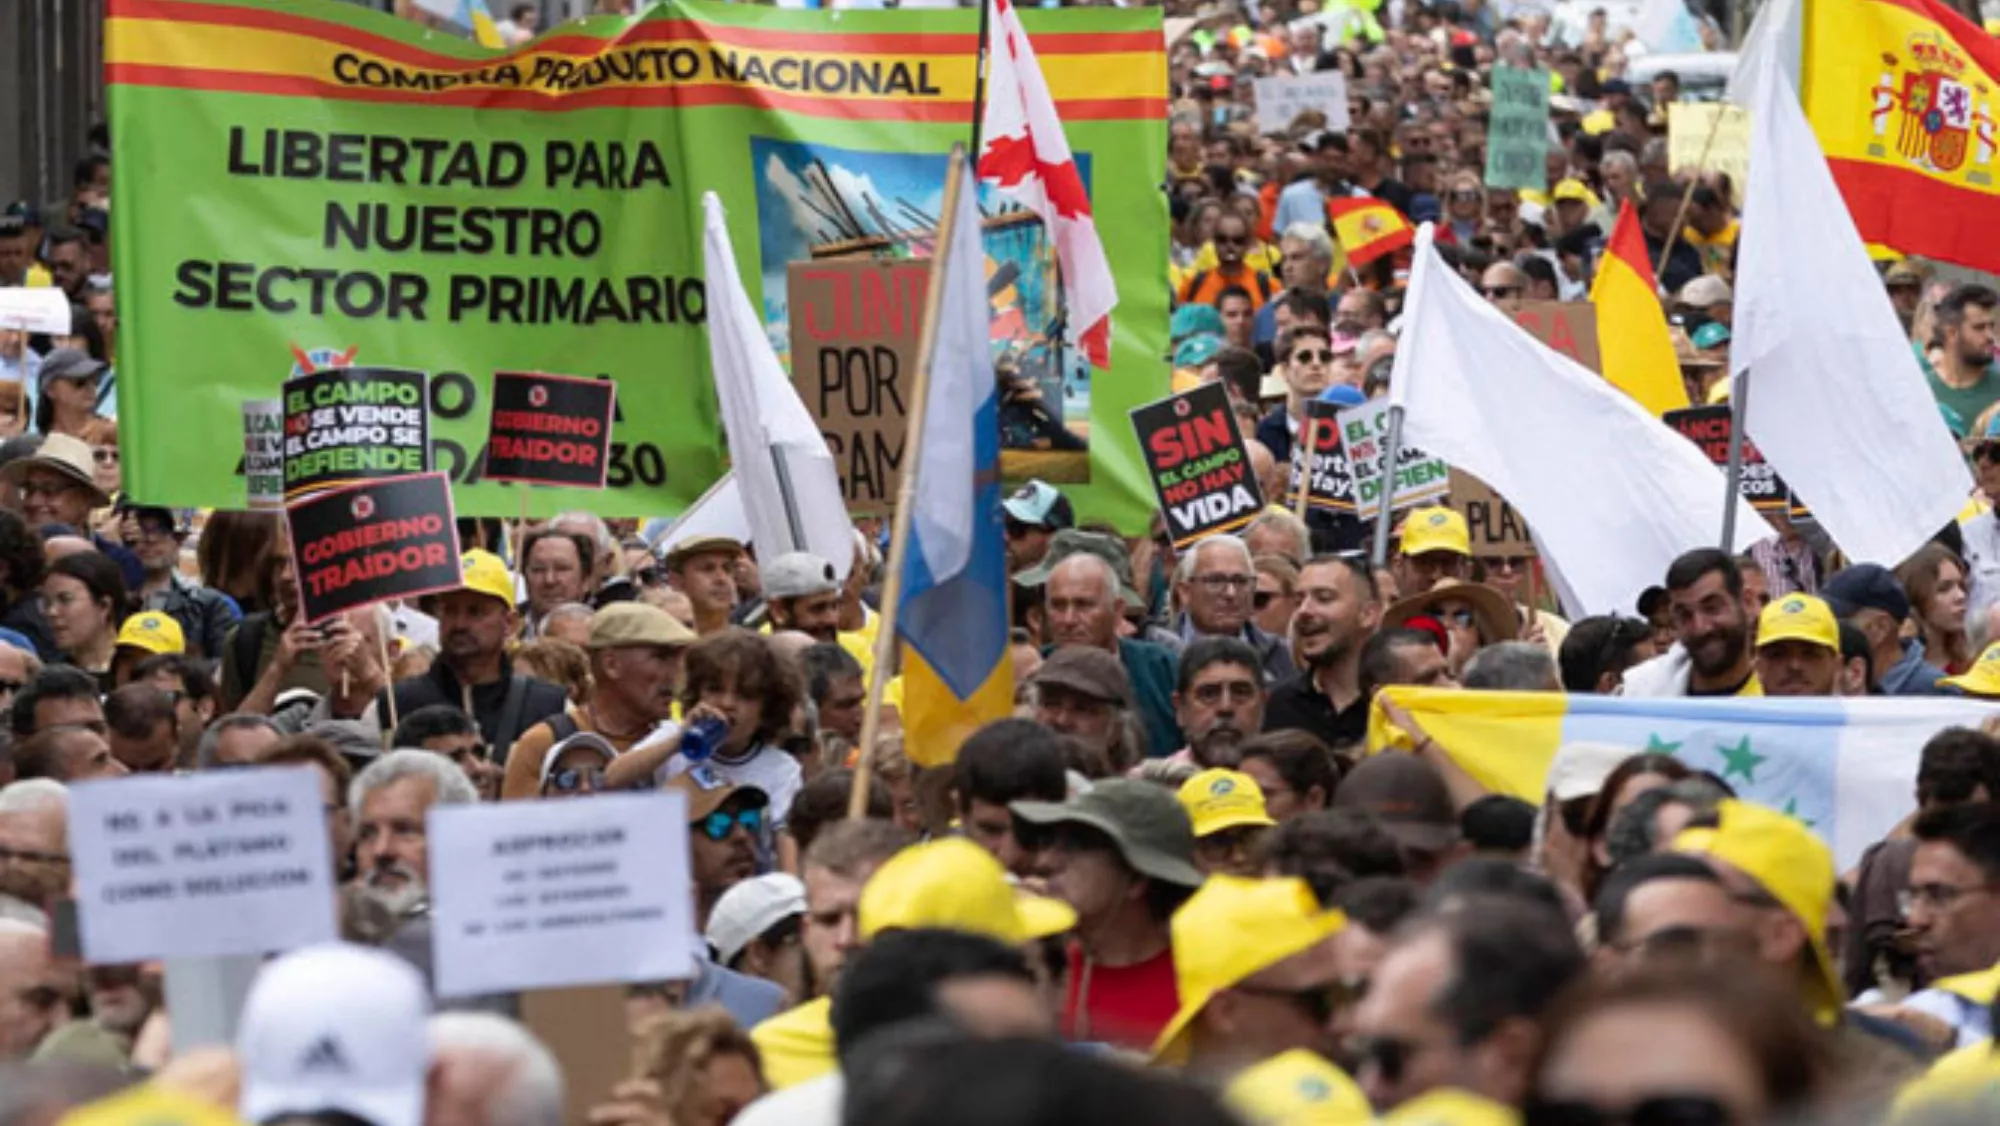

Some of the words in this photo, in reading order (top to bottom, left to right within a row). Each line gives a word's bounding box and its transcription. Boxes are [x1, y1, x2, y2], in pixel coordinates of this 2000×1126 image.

[710, 50, 940, 96] NACIONAL
[228, 126, 527, 189] LIBERTAD
[545, 140, 671, 190] PARA
[324, 202, 601, 257] NUESTRO
[173, 260, 428, 320] SECTOR
[449, 275, 707, 325] PRIMARIO
[804, 269, 929, 341] JUNT
[287, 390, 310, 413] EL
[313, 381, 419, 405] CAMPO
[819, 345, 905, 418] POR
[306, 426, 387, 449] CAMPO
[391, 427, 421, 445] SE
[311, 408, 335, 427] SE
[339, 405, 421, 426] VENDE
[1150, 408, 1233, 469] SIN
[1345, 419, 1372, 443] EL
[286, 447, 422, 482] DEFIENDE
[1159, 471, 1180, 487] EL
[1181, 448, 1240, 477] CAMPO
[1164, 480, 1198, 504] NO
[1201, 462, 1244, 491] HAY
[1170, 483, 1257, 531] VIDA
[1467, 501, 1531, 544] PLA
[303, 513, 443, 565] GOBIERNO
[308, 542, 447, 597] TRAIDOR
